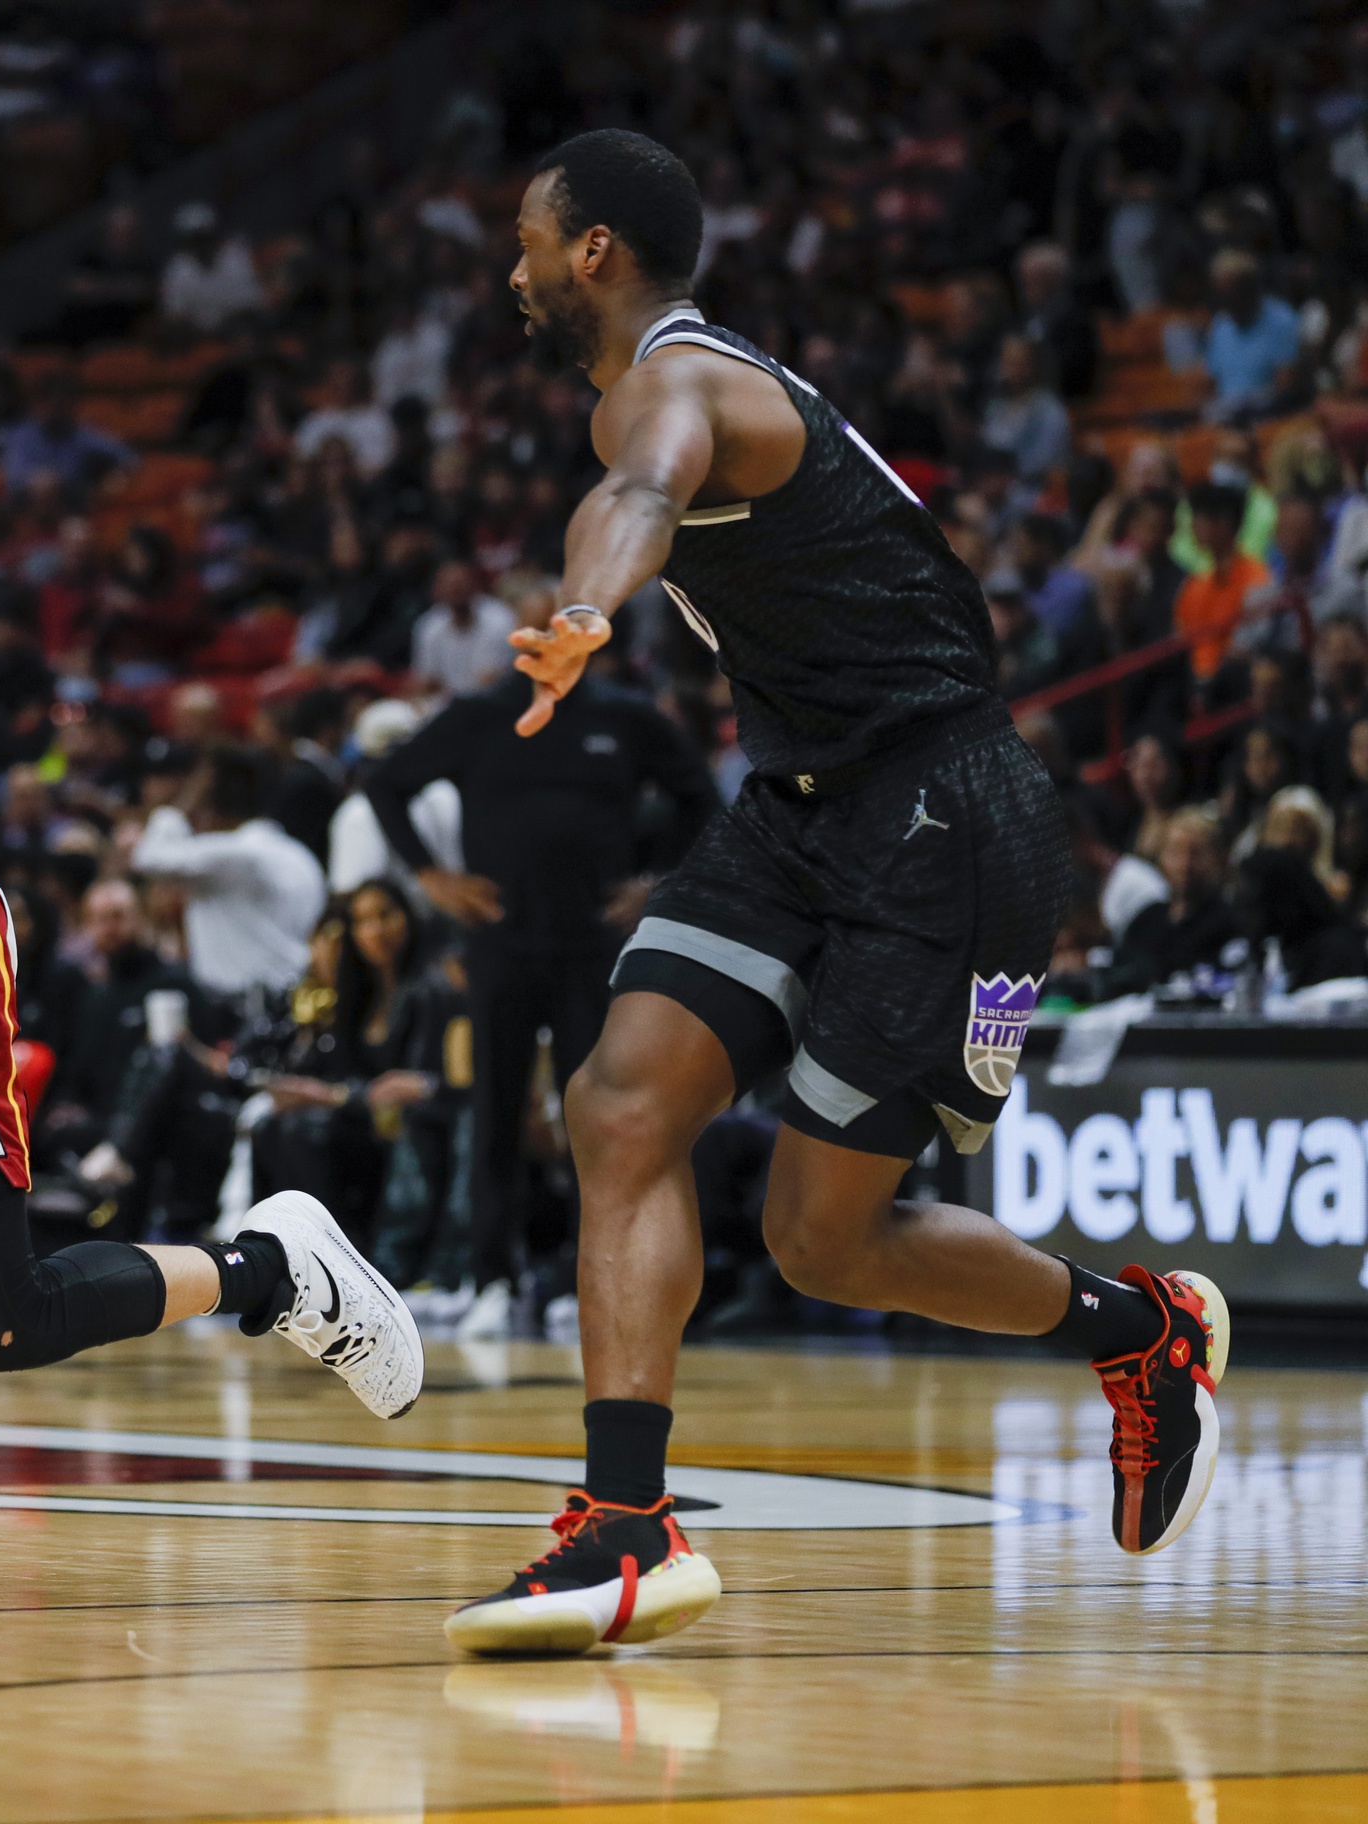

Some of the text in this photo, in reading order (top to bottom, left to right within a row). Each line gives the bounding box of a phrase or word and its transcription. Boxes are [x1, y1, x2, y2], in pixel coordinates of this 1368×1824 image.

[978, 1007, 1032, 1020] SACRAM
[970, 1021, 1029, 1048] KIN
[993, 1073, 1368, 1288] betwa
